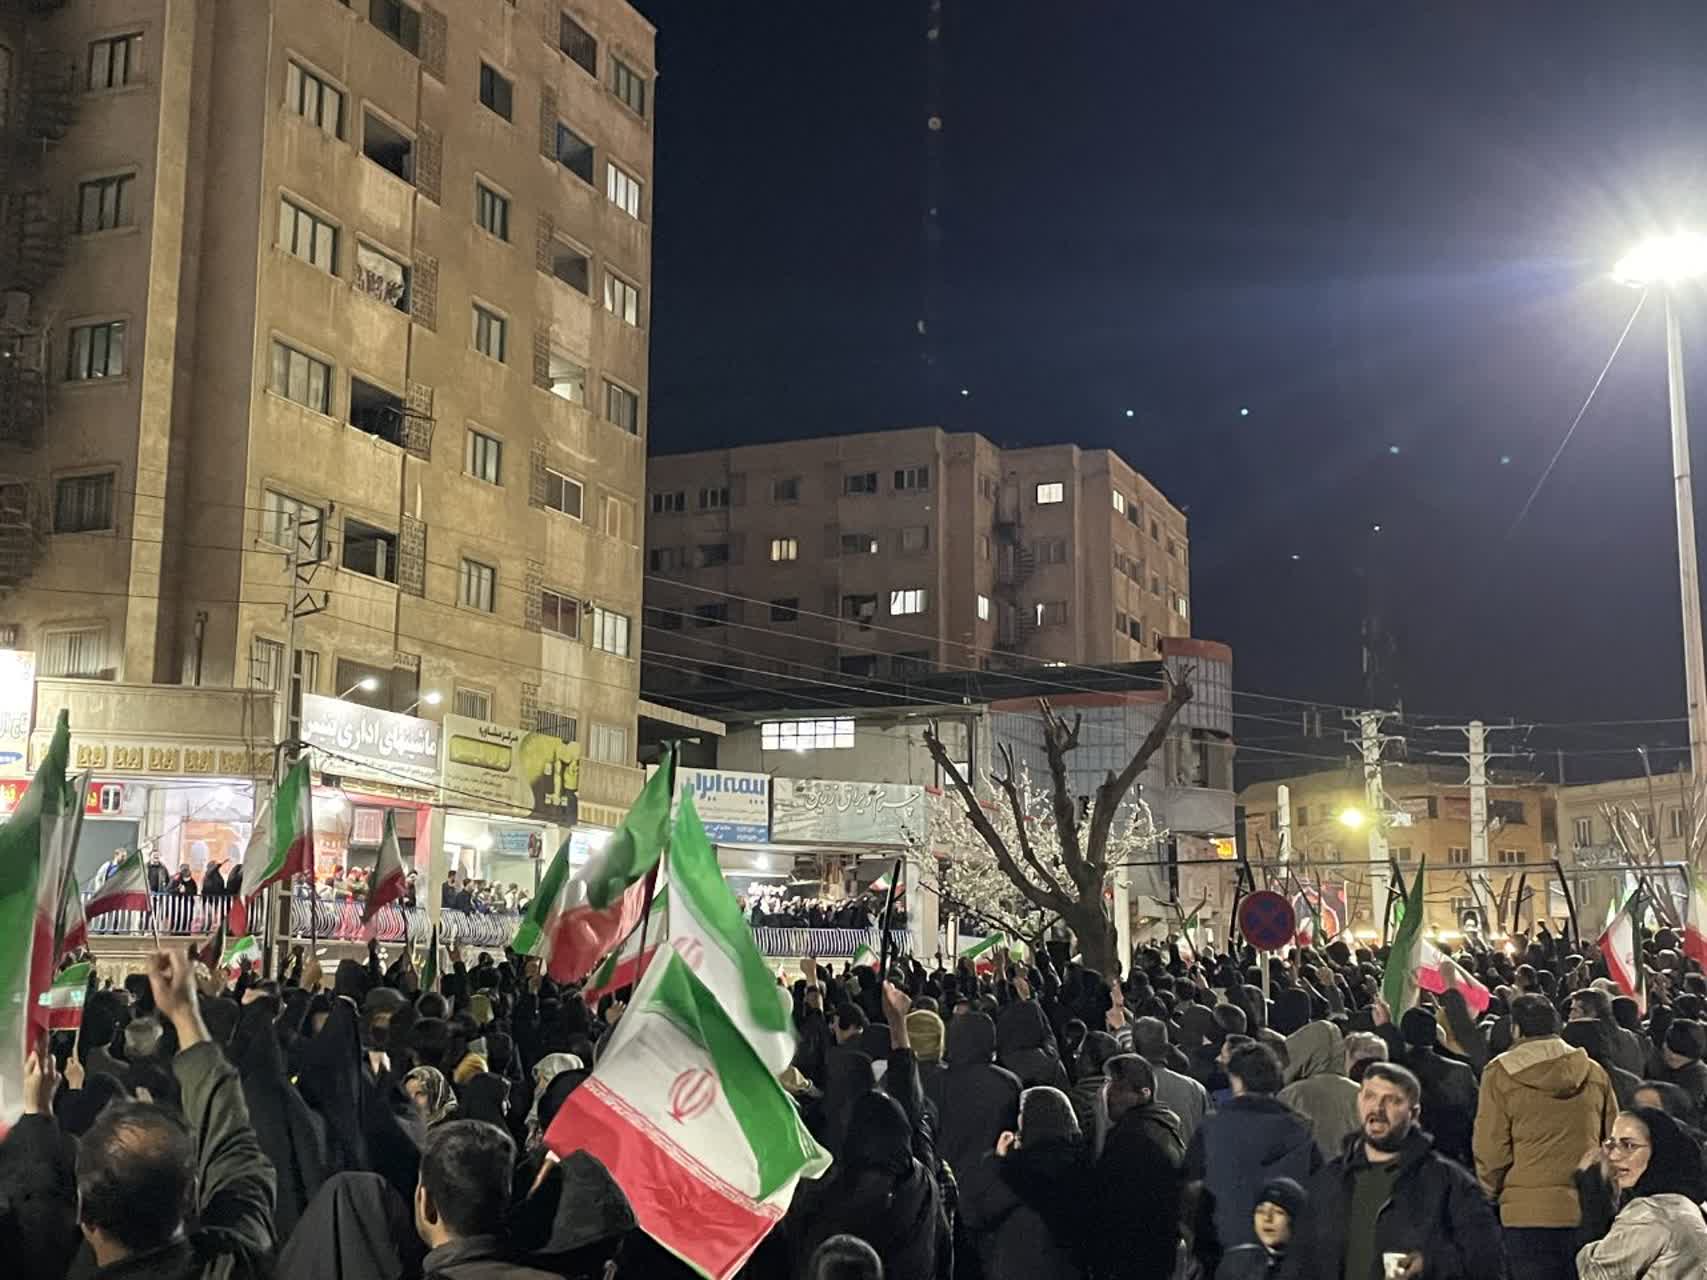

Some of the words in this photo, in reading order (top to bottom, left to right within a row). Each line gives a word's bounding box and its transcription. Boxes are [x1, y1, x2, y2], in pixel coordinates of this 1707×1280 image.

[336, 713, 379, 749] اداری
[723, 776, 765, 804] بیمه
[873, 788, 920, 823] چرم
